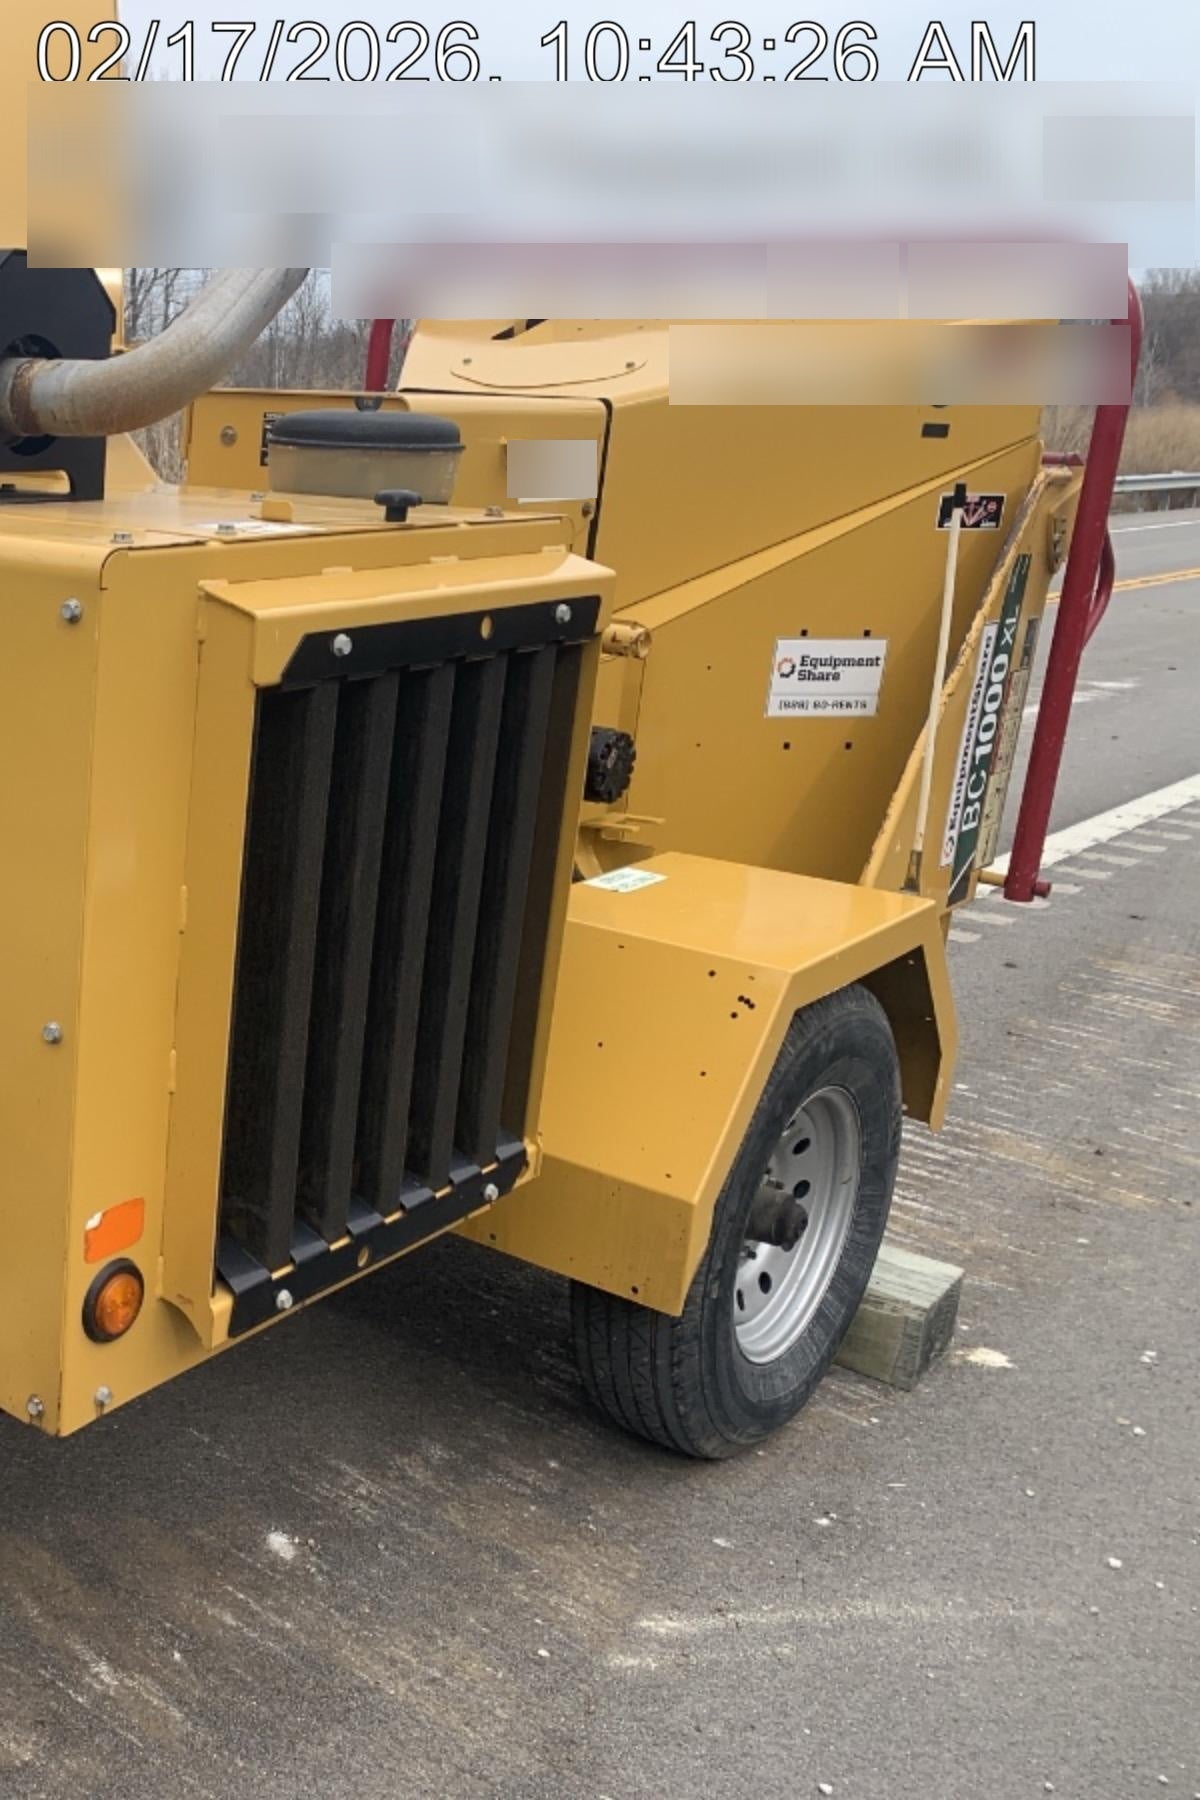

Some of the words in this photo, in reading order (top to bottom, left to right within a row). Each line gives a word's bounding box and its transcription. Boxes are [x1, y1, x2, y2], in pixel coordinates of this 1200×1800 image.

[1000, 606, 1020, 647] XL
[799, 655, 881, 670] Equipment
[797, 669, 841, 681] Share
